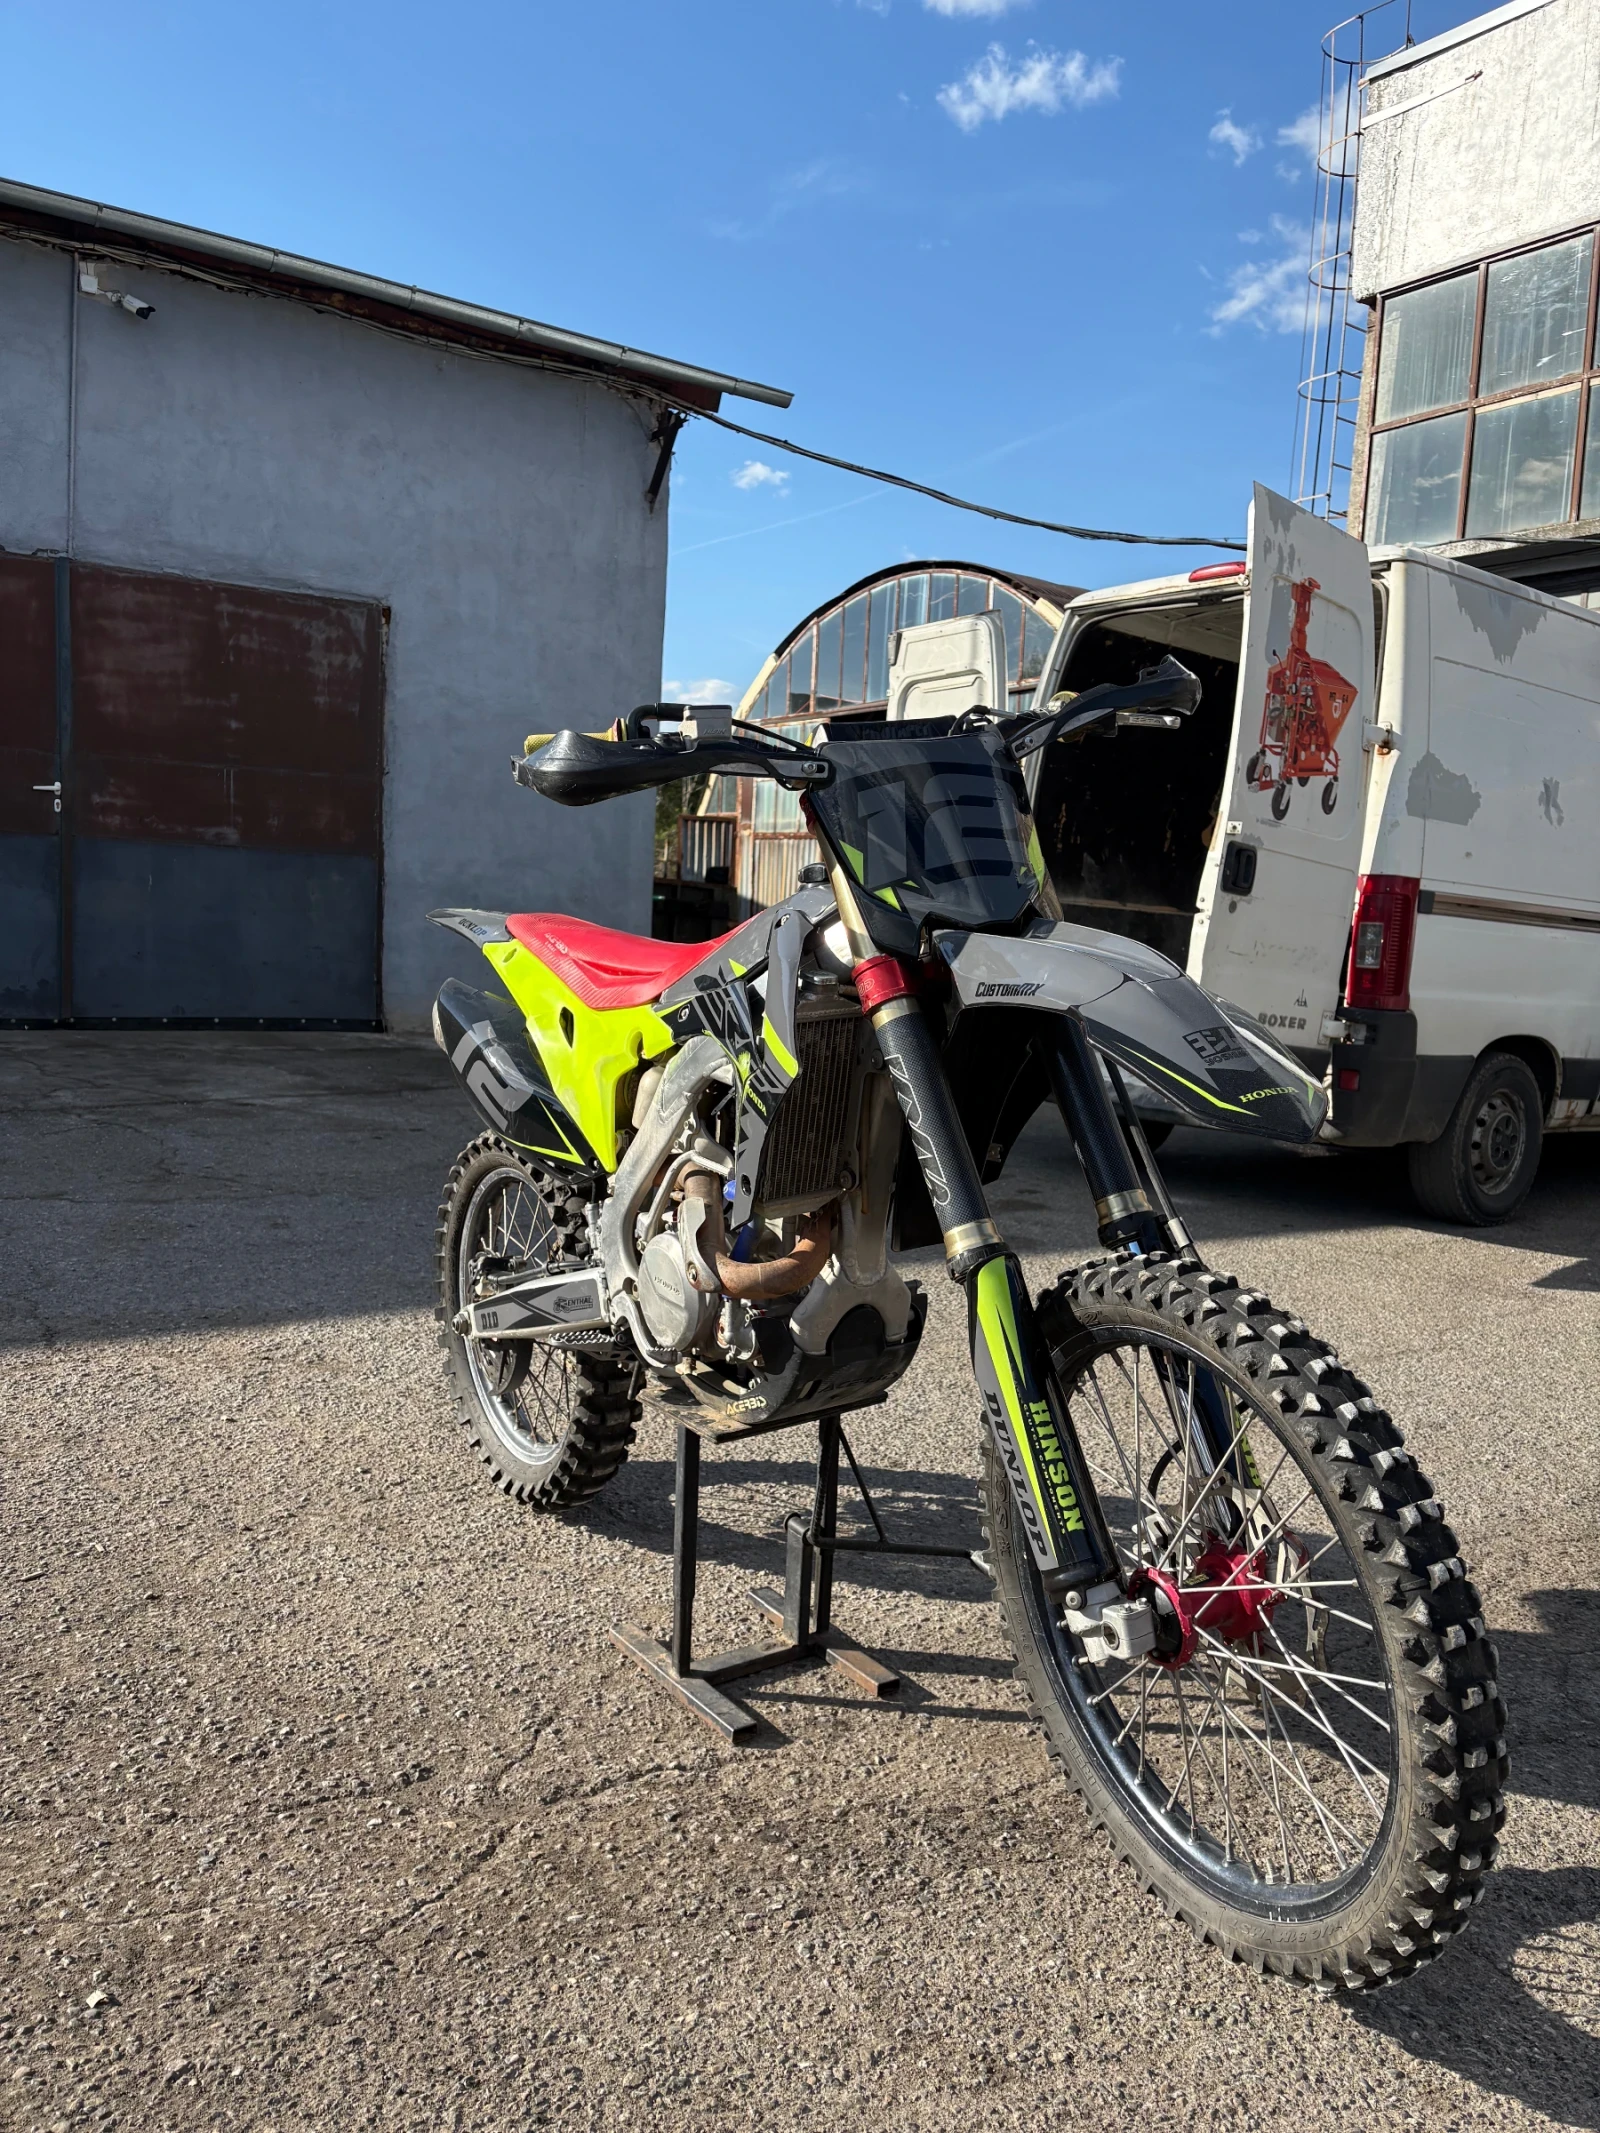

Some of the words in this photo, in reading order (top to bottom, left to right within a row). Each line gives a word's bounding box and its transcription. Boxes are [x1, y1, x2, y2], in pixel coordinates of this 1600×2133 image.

[459, 918, 488, 937] DUNLOP
[1257, 1012, 1308, 1030] BOXER
[1238, 1086, 1300, 1103] HONDA
[725, 1396, 767, 1416] ACERBIS
[984, 1389, 1049, 1557] DUNLOP
[1023, 1403, 1040, 1449] CLUTCH
[1039, 1454, 1067, 1535] COMPONENTS
[1029, 1399, 1086, 1533] HINSON
